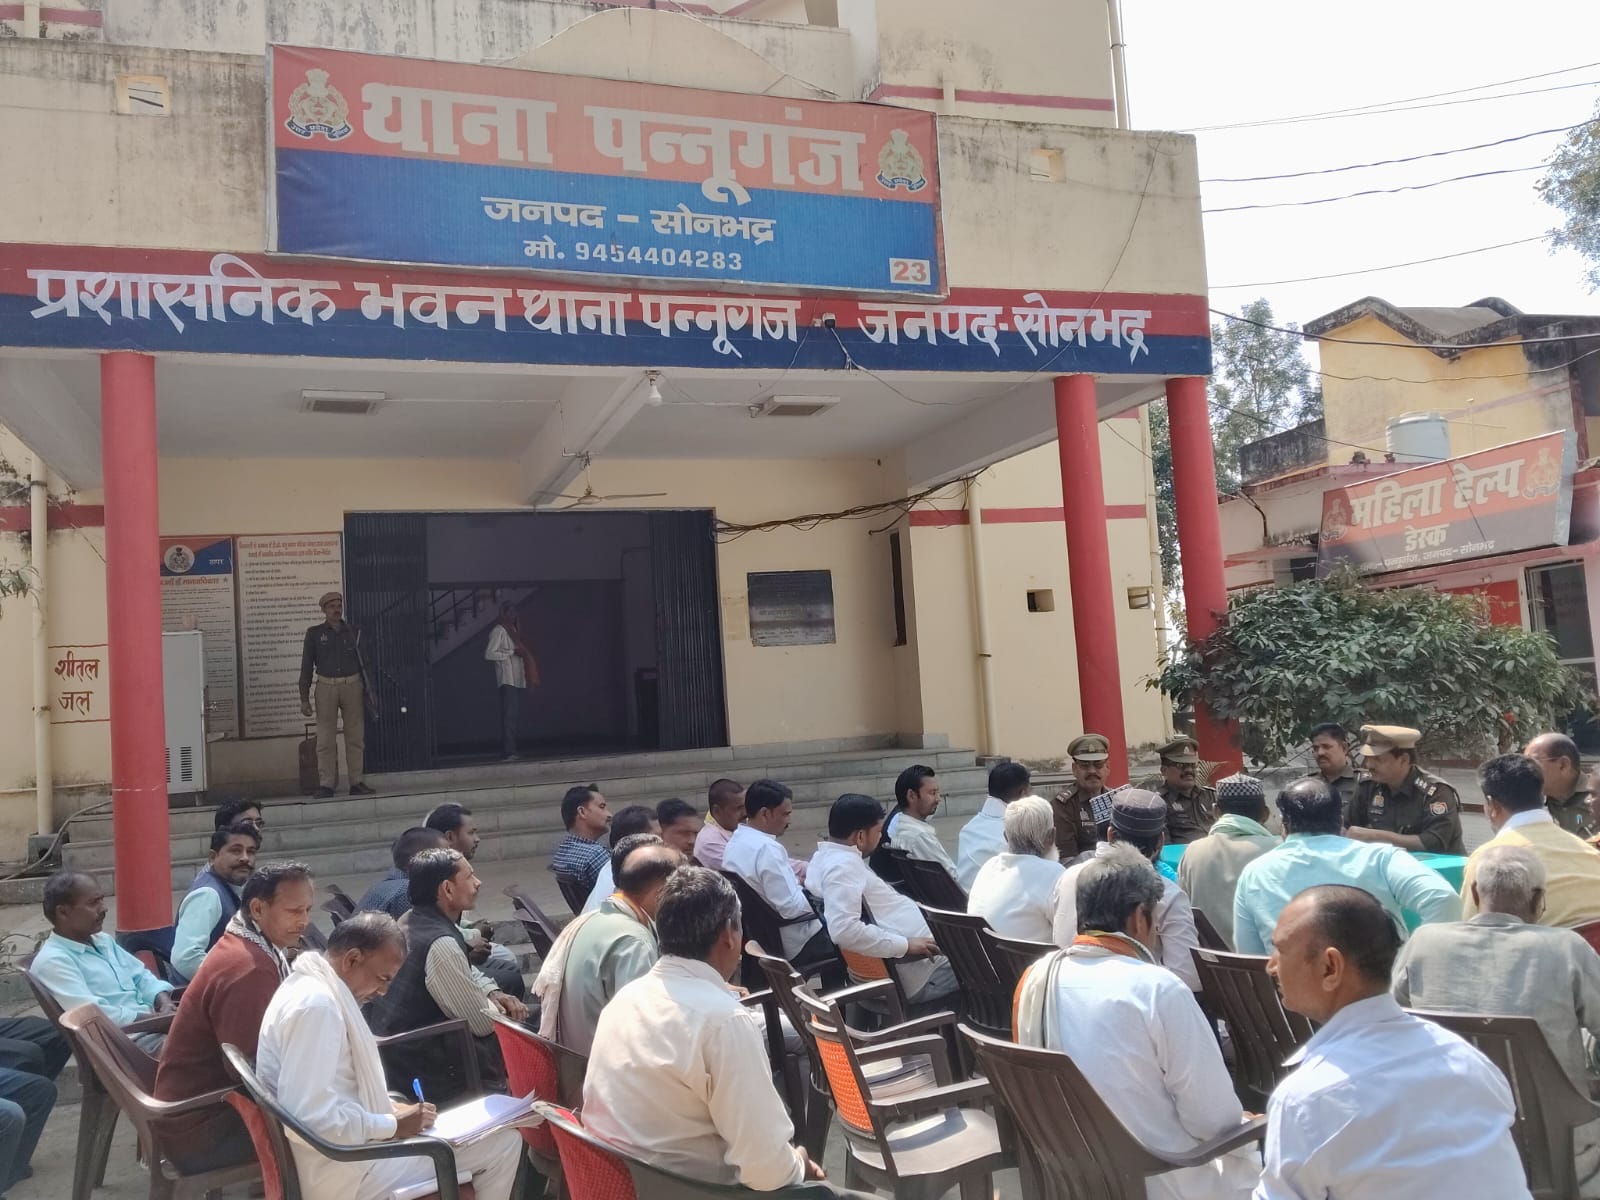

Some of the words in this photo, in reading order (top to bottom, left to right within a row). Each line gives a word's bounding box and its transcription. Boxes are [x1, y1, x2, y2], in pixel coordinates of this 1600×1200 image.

[361, 81, 557, 165] थाना
[585, 104, 867, 206] पन्नूगंज
[480, 197, 607, 229] जनपद
[650, 202, 777, 246] सोनभद्र
[523, 234, 566, 260] मो.
[575, 242, 742, 270] 9454404283
[893, 261, 927, 282] 23
[26, 253, 341, 335] प्रशासनिक
[353, 281, 512, 332] भवन
[517, 288, 632, 337] थाना
[1351, 477, 1448, 529] महिला
[1452, 459, 1526, 510] हेल्प
[1404, 523, 1450, 551] डेस्क
[54, 650, 101, 682] शीतल
[58, 691, 94, 716] जल
